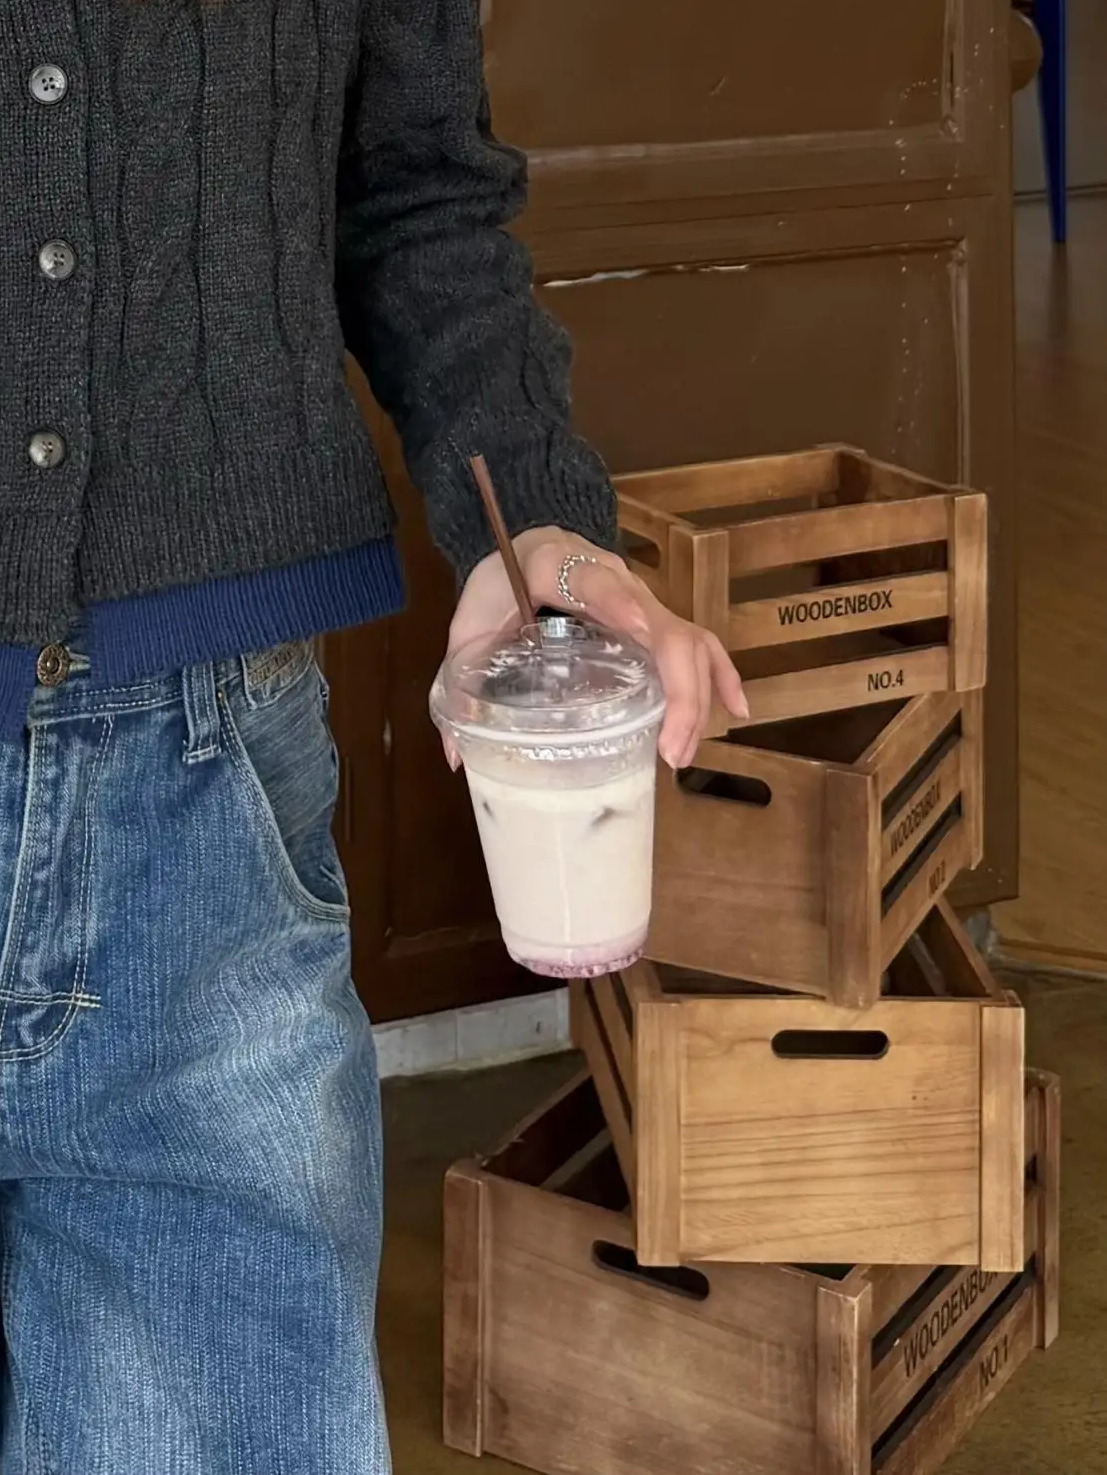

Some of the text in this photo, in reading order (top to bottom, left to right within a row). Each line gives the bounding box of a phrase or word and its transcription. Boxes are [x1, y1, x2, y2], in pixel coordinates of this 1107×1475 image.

[777, 589, 894, 626] WOODENBOX
[867, 669, 905, 693] NO.4
[904, 1270, 998, 1378] WOODENBO
